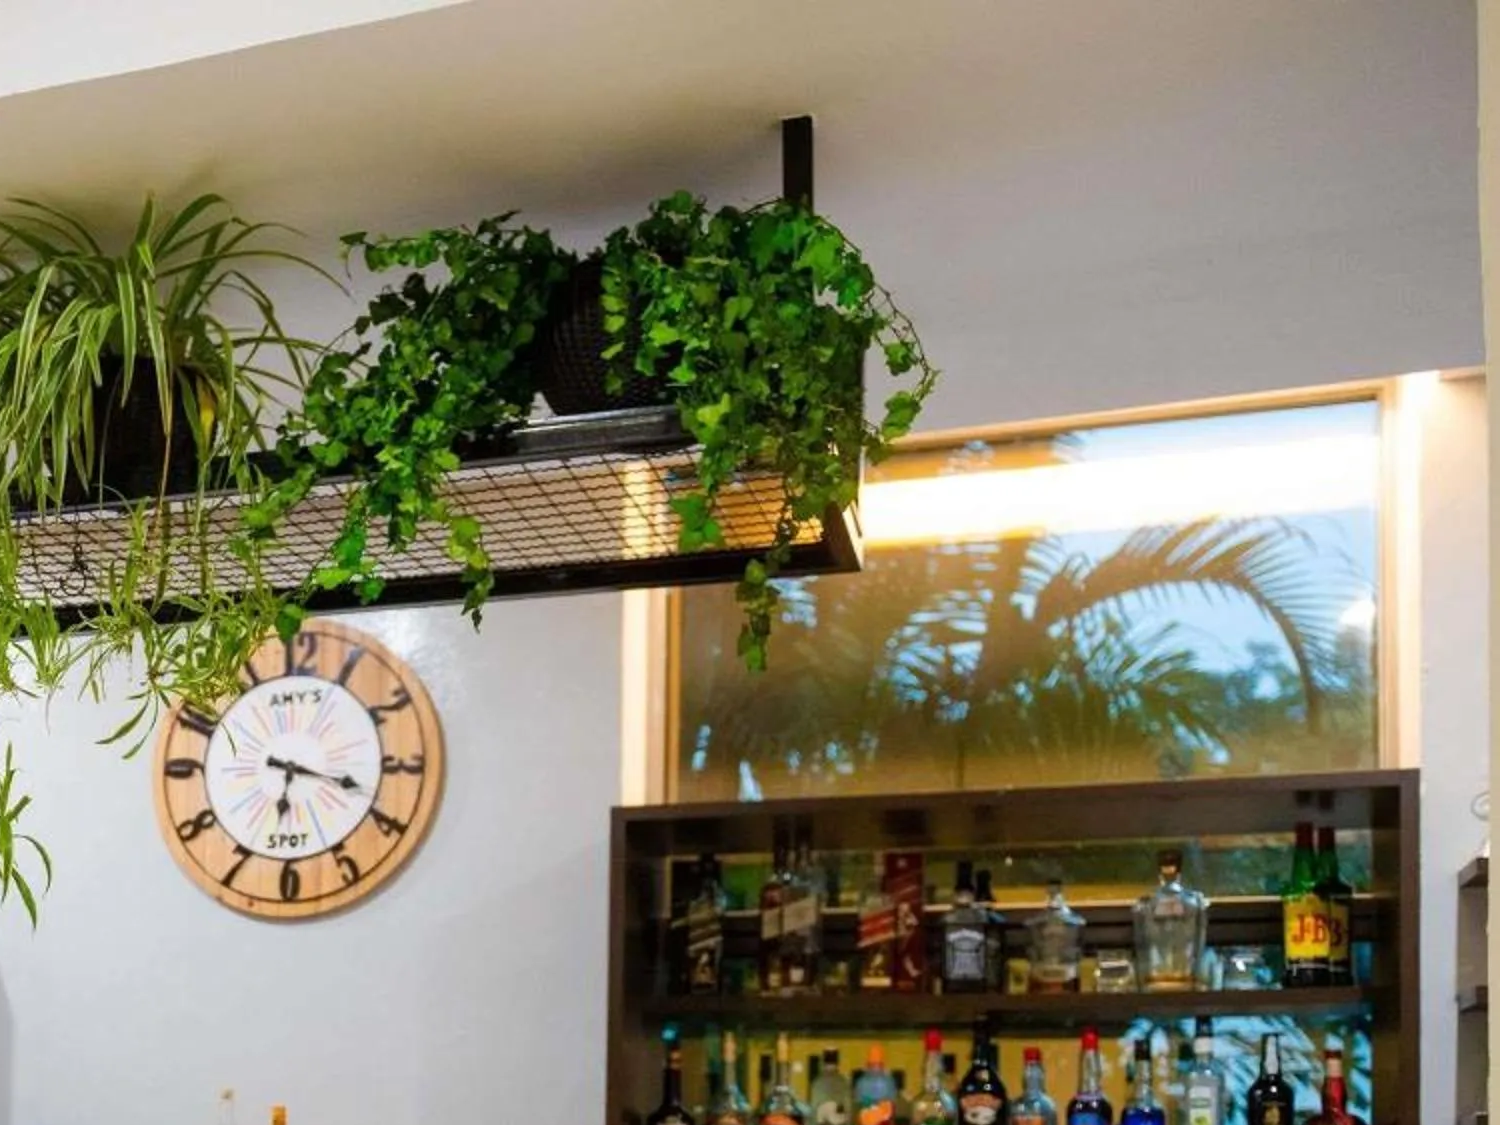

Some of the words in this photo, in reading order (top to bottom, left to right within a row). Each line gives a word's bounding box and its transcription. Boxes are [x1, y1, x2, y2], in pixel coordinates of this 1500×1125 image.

[270, 689, 323, 708] AMY'S
[368, 688, 412, 726] 2
[164, 758, 206, 779] 9
[381, 755, 425, 775] 3
[177, 809, 217, 843] 8
[368, 806, 409, 838] 4
[267, 833, 309, 850] SPOT
[220, 843, 253, 888] 7
[280, 859, 300, 901] 6
[329, 842, 361, 887] 5
